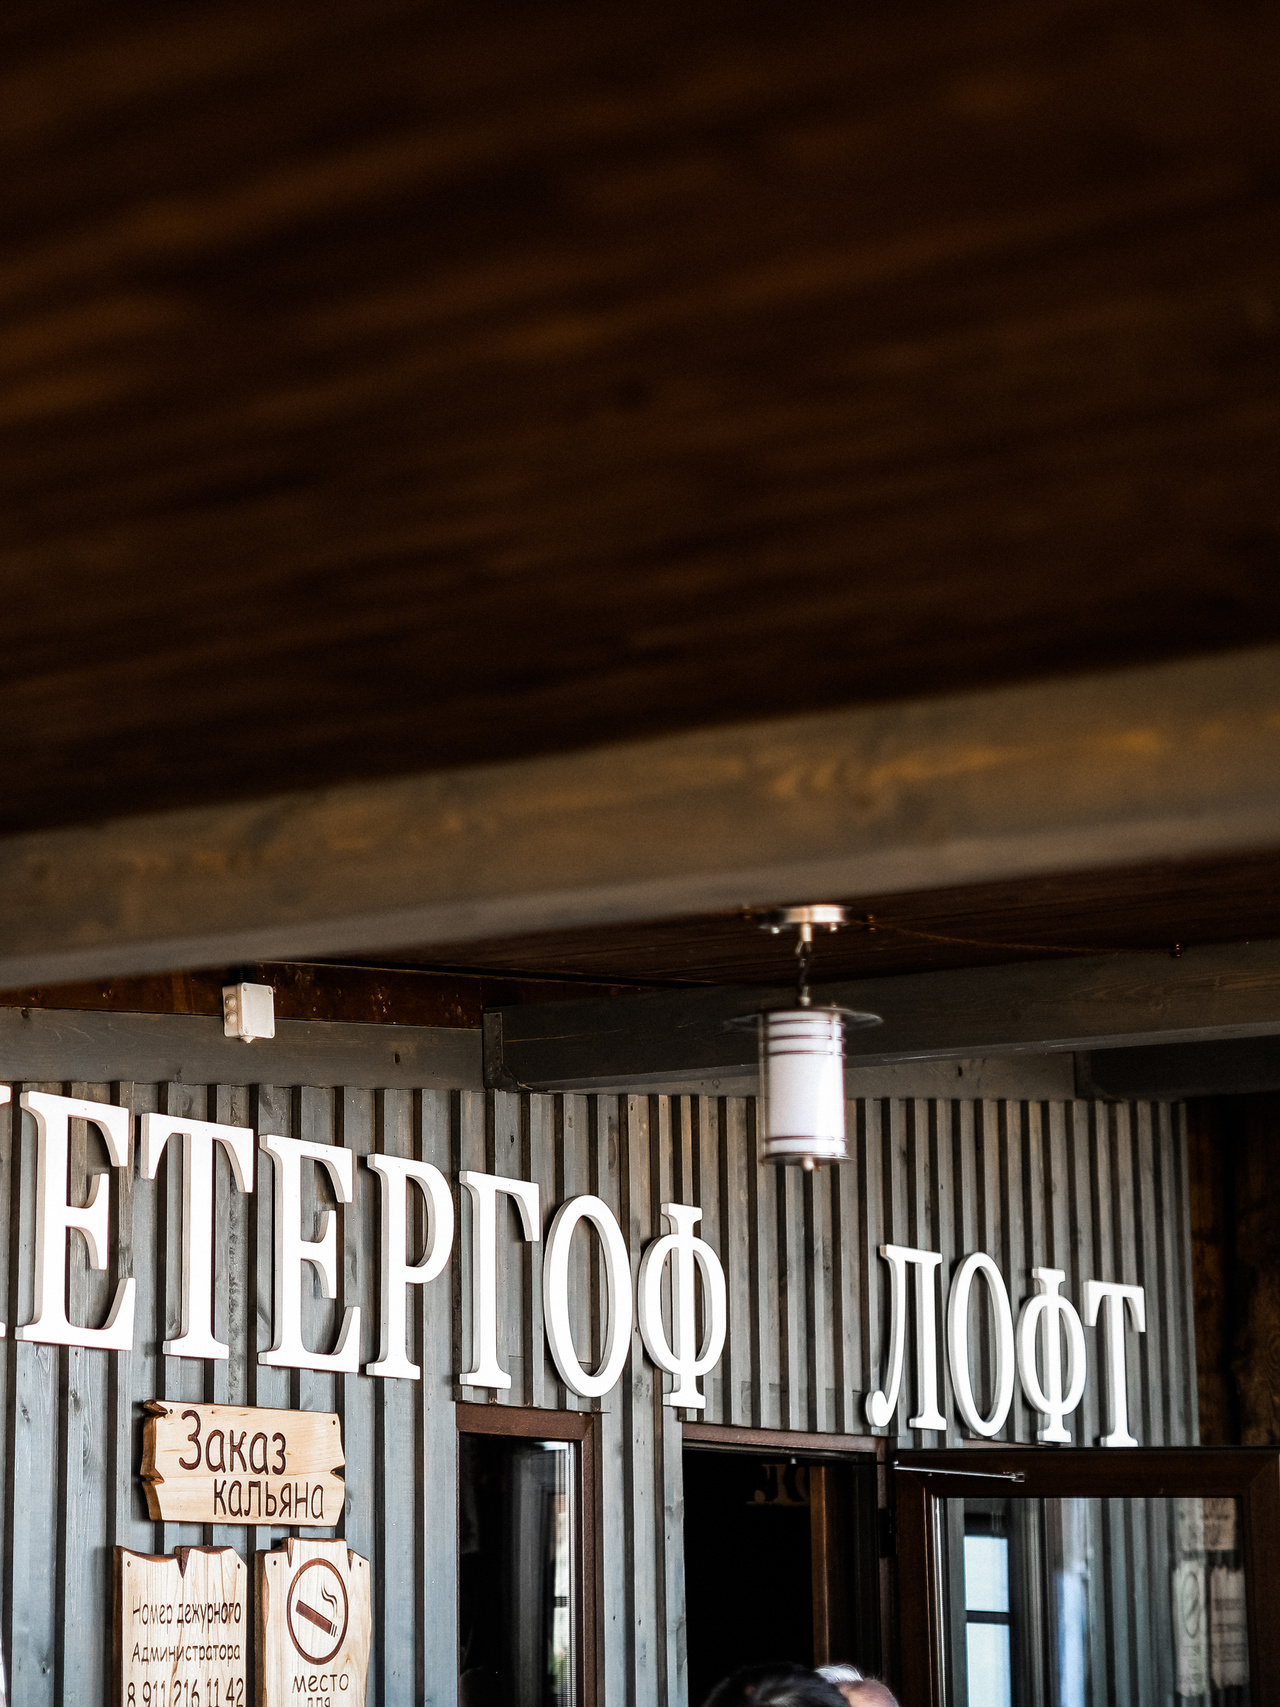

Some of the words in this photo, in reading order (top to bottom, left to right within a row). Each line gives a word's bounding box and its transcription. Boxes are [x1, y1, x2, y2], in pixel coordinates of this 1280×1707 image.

[865, 1244, 1146, 1447] ЛОФТ
[178, 1409, 287, 1476] Заказ
[213, 1478, 325, 1520] кальяна
[132, 1595, 174, 1635] Номер
[176, 1602, 242, 1635] дежурного
[131, 1641, 241, 1669] Администратора
[291, 1673, 350, 1694] место
